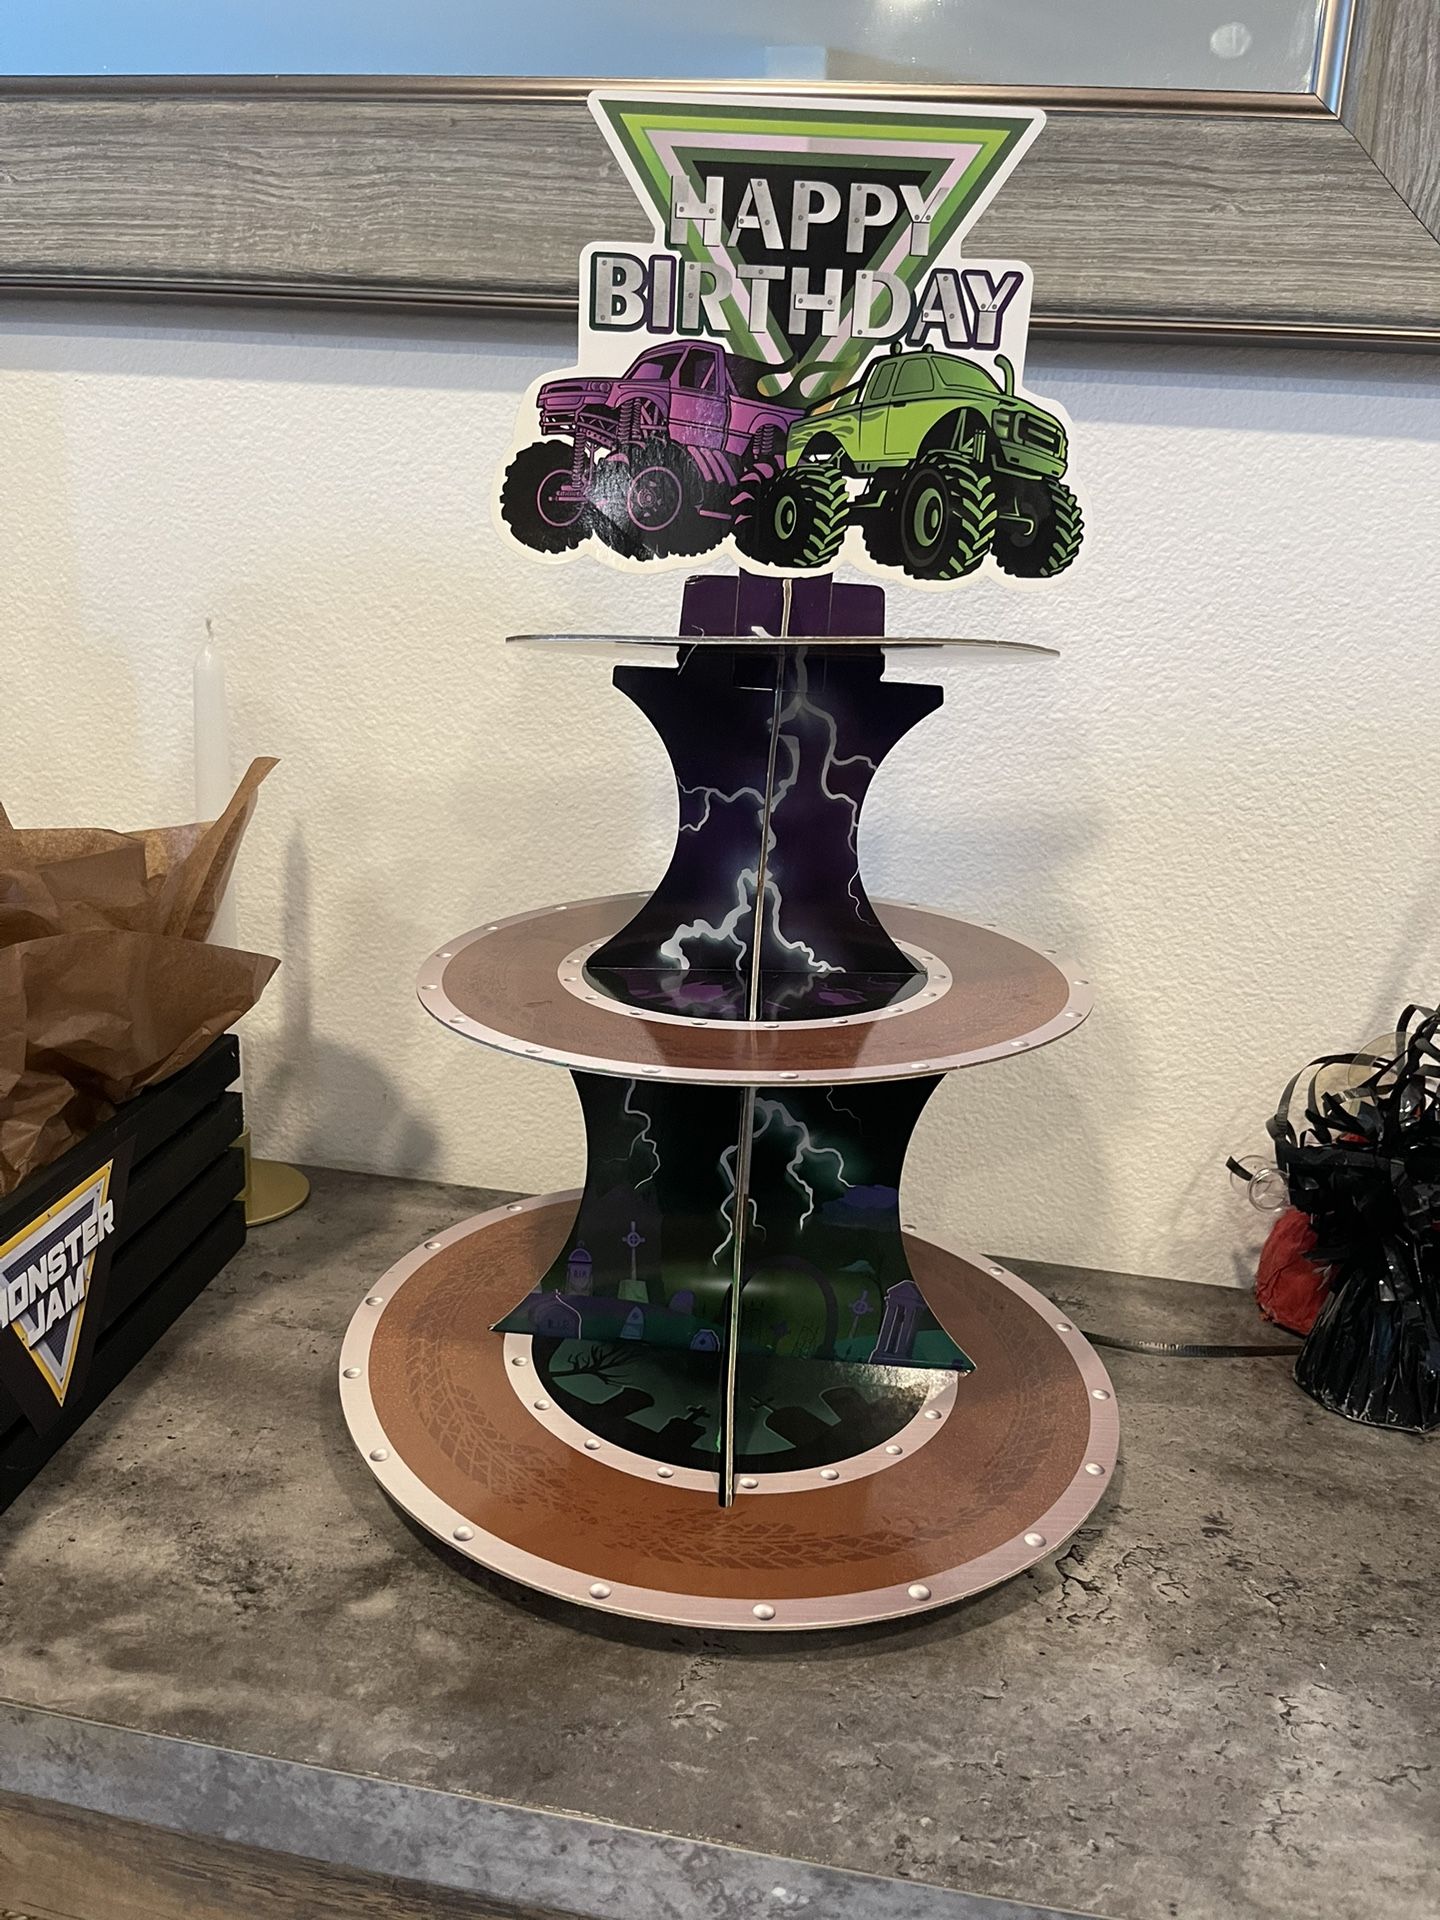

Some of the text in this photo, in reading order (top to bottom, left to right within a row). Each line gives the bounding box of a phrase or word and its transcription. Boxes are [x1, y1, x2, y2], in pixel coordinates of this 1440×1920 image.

[670, 174, 950, 257] HAPPY
[592, 254, 1021, 347] BIRTHDAY
[28, 1264, 86, 1348] JAM
